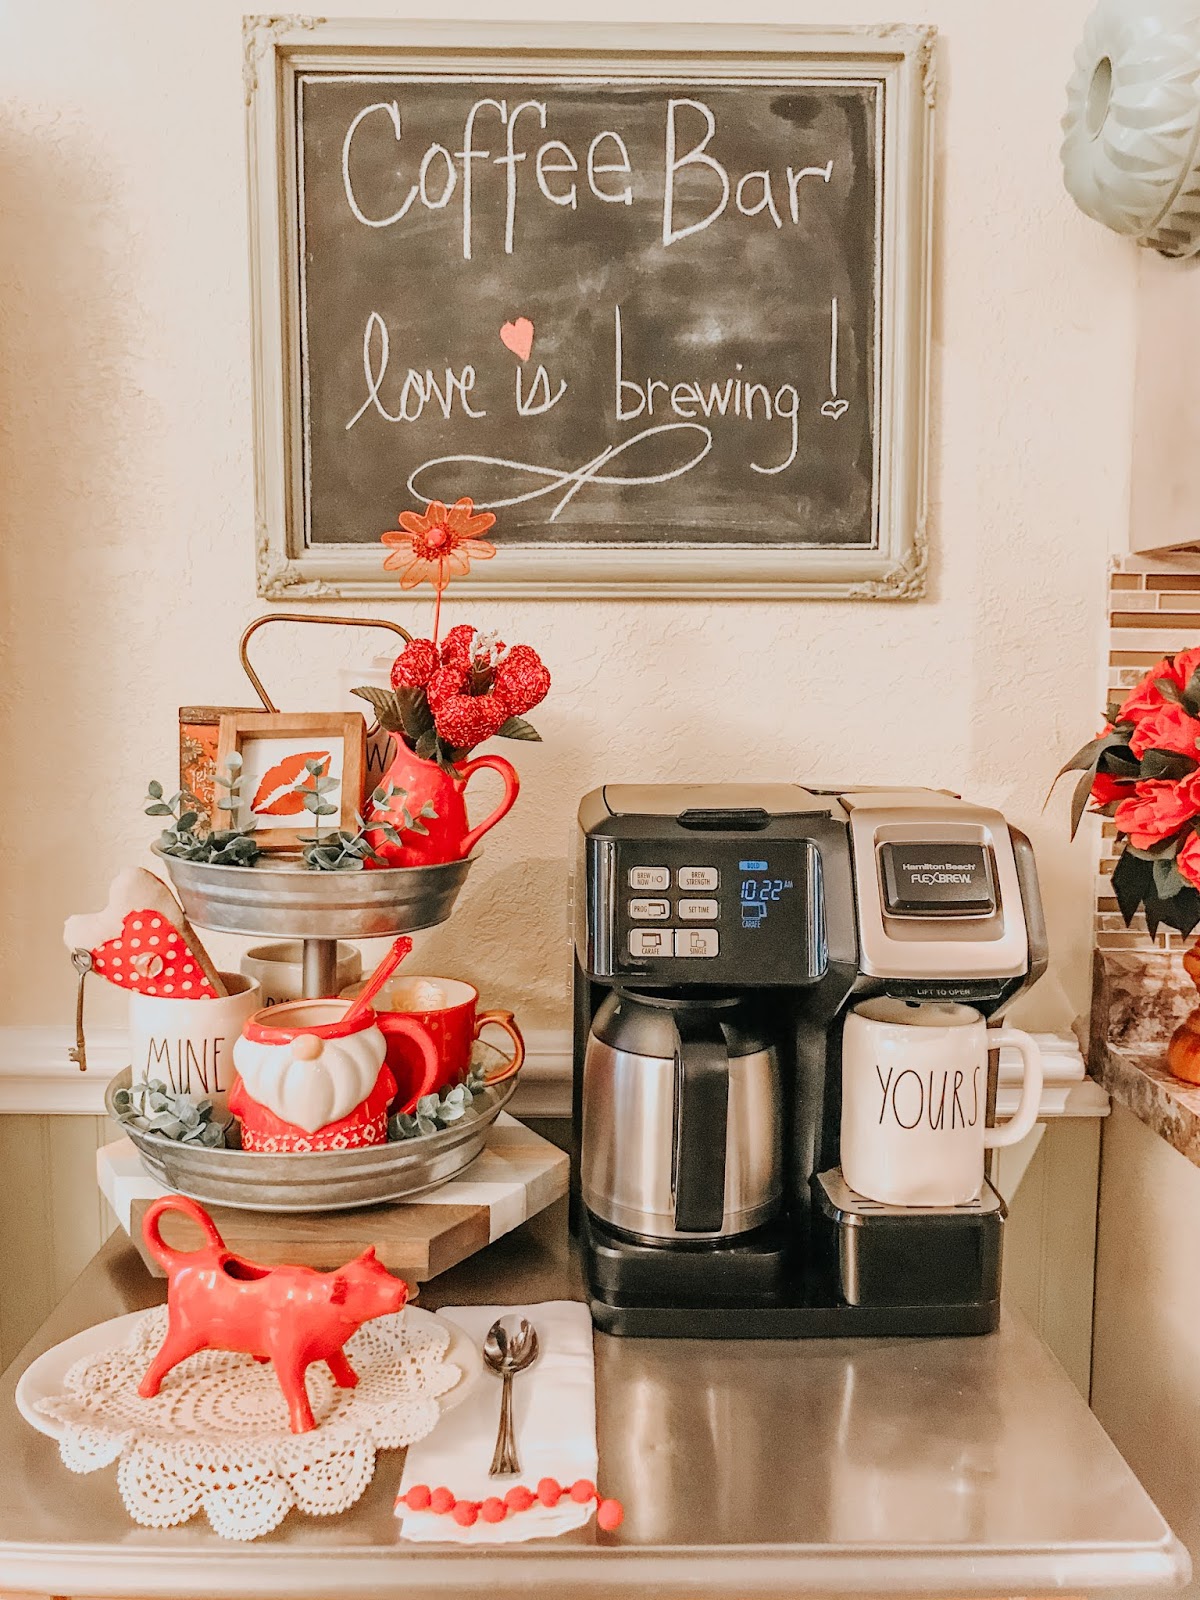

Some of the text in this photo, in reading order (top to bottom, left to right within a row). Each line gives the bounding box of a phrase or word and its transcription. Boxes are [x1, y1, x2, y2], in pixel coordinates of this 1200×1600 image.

[342, 98, 834, 260] Coffee Bar
[345, 310, 487, 430] love
[500, 316, 568, 417] is
[614, 303, 802, 475] brewing
[910, 871, 971, 886] FLEXBREW
[633, 905, 648, 913] PROG
[641, 947, 660, 955] CARAFE
[690, 947, 707, 955] SINGLE
[146, 1037, 226, 1095] MINE
[875, 1064, 981, 1131] YOURS
